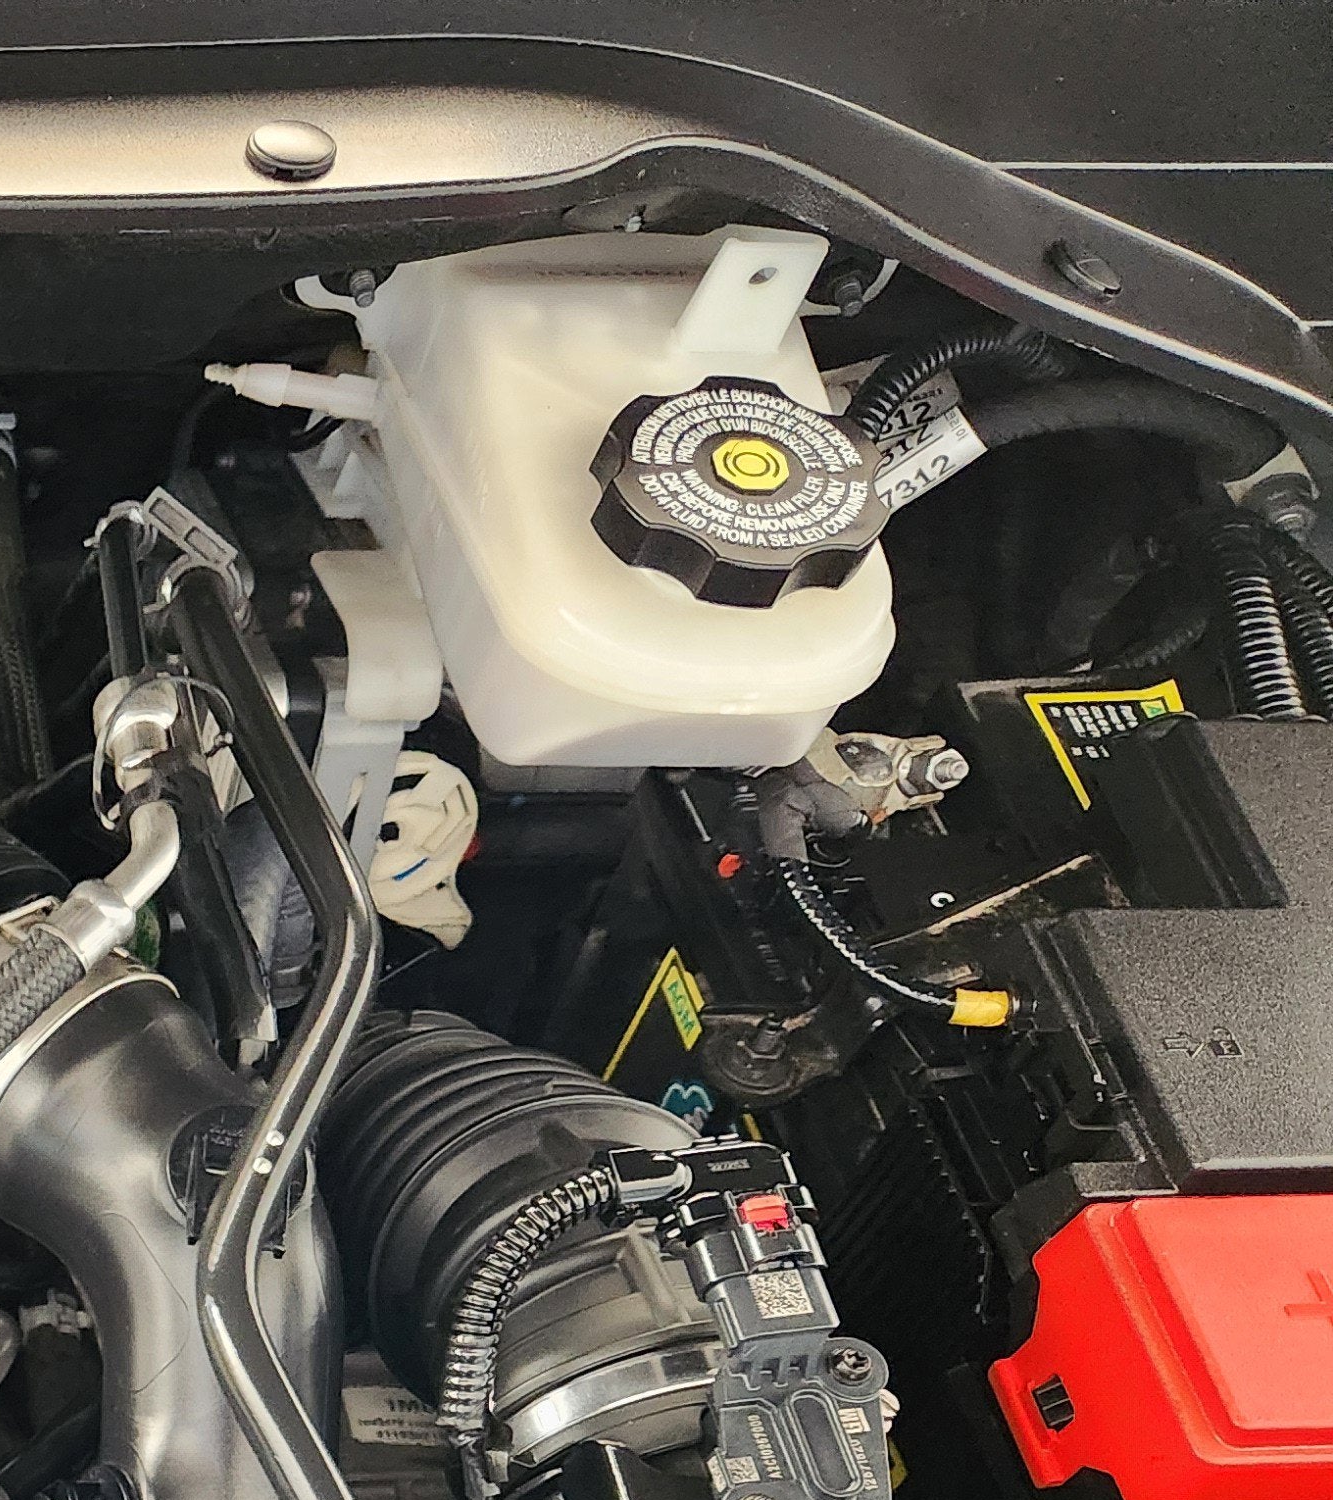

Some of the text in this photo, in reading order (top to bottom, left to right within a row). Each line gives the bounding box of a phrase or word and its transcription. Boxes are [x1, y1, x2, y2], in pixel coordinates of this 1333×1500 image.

[712, 388, 731, 403] LE
[792, 406, 834, 435] AVANT
[659, 472, 689, 503] CAP
[683, 492, 734, 528] BEFORE
[824, 479, 847, 507] ONLY
[746, 498, 793, 517] CLEAN
[792, 475, 824, 509] FILLER
[668, 502, 707, 530] FLUID
[707, 522, 754, 546] FROM
[769, 527, 828, 547] SEALED
[838, 1407, 868, 1434] GM
